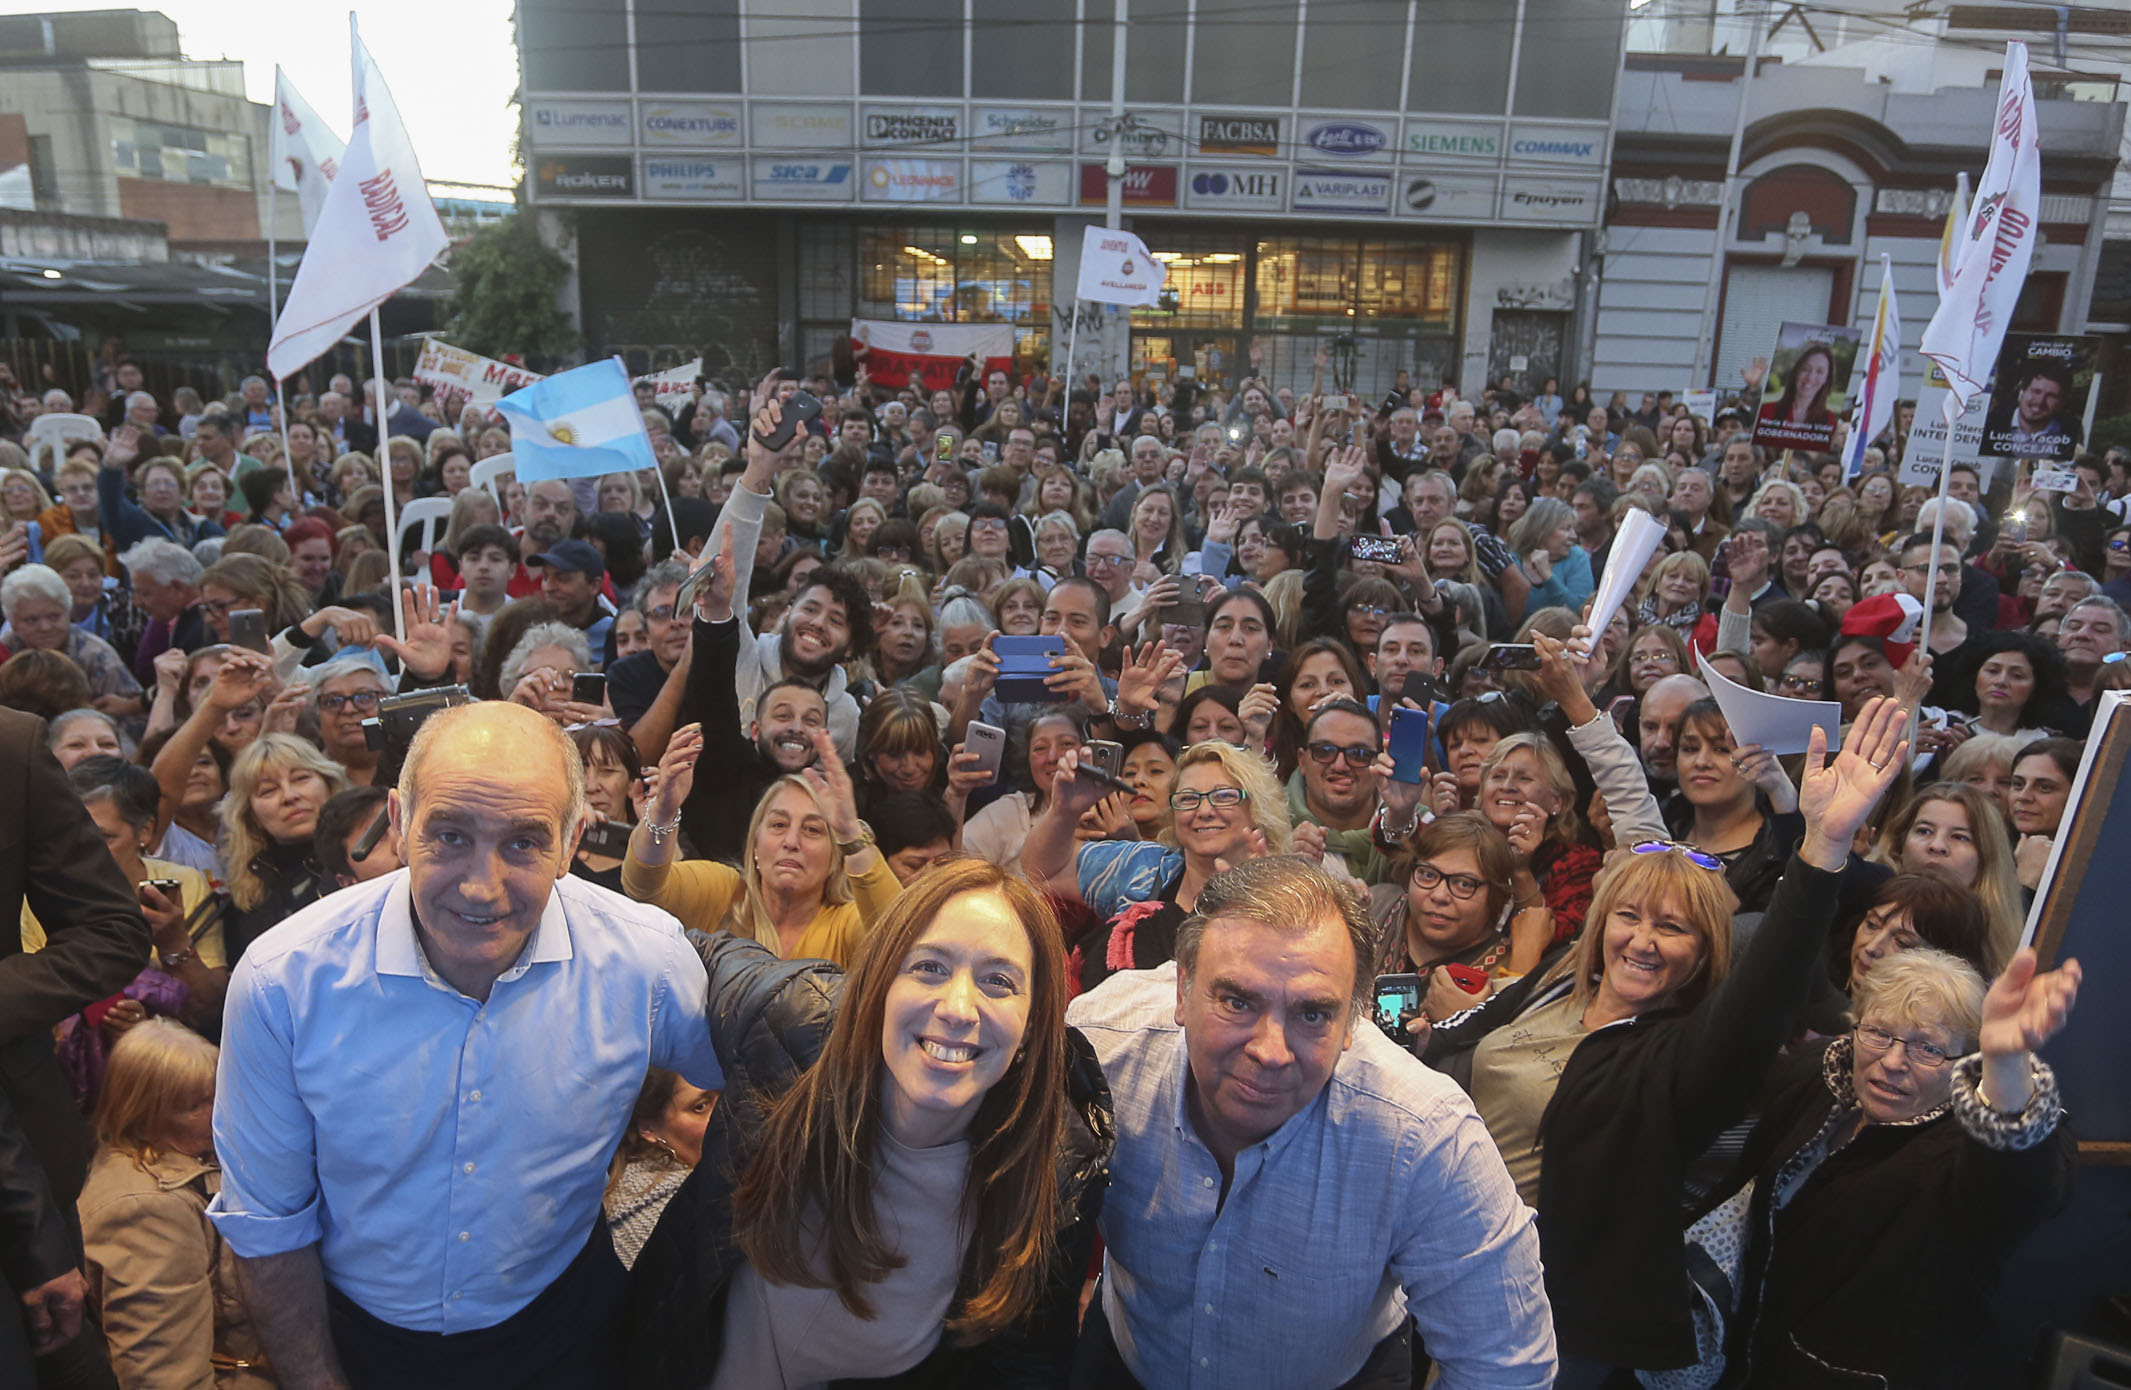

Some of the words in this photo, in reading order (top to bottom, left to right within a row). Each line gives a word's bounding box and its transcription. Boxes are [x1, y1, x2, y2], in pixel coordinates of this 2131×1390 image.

[552, 110, 626, 128] Lumenac
[646, 117, 738, 131] CONEXTUBE
[986, 113, 1057, 129] Schneider
[1202, 120, 1277, 141] FACBSA
[1408, 133, 1497, 152] SIEMENS
[647, 163, 715, 179] PHILIPS
[1231, 172, 1279, 197] MH
[1315, 182, 1387, 197] VARIPLAST
[357, 166, 410, 243] RADICAL
[1191, 281, 1225, 296] ABB
[2027, 347, 2072, 358] CAMBIO
[1757, 427, 1830, 443] GOBERNADORA
[1989, 431, 2029, 443] Lucas
[2030, 431, 2071, 445] Yacob
[1992, 441, 2062, 456] CONCEJAL
